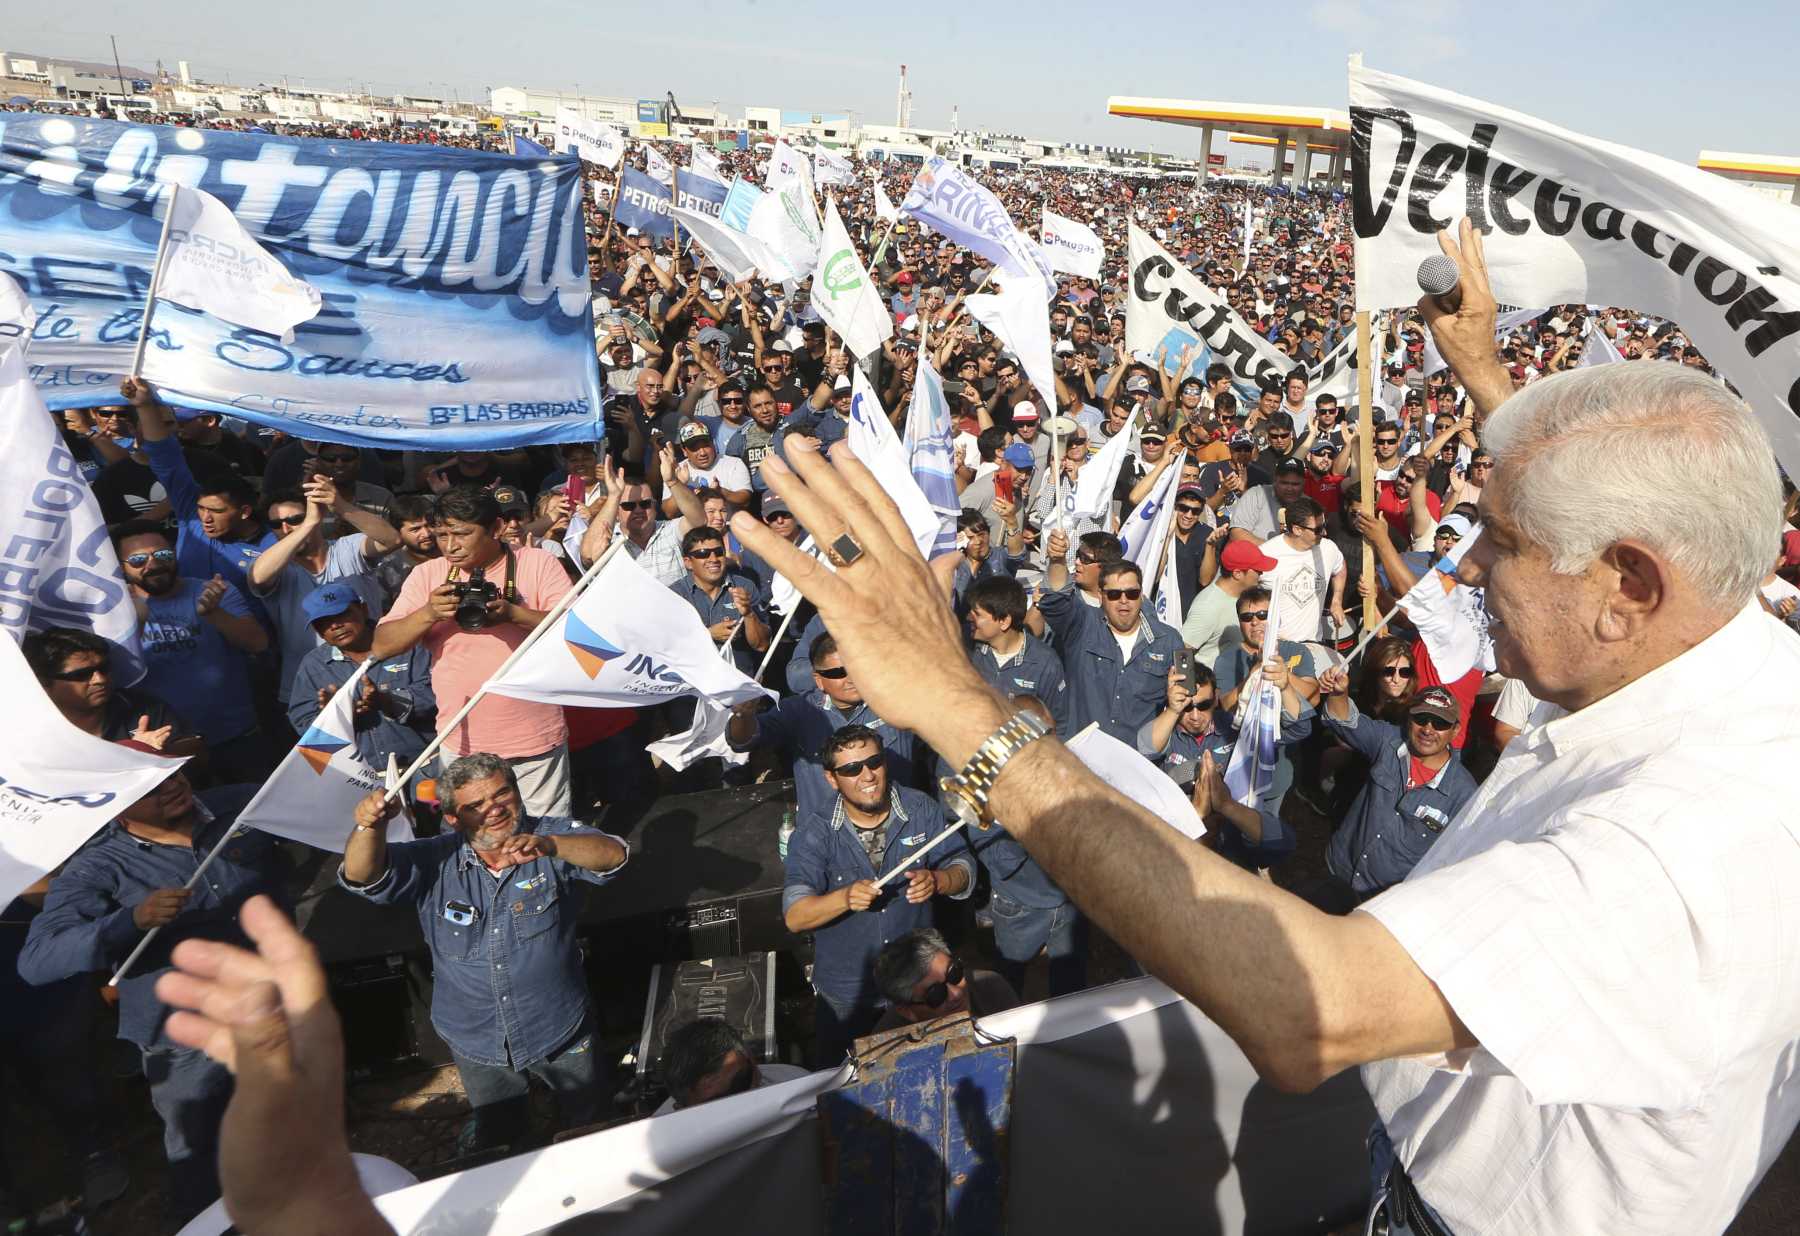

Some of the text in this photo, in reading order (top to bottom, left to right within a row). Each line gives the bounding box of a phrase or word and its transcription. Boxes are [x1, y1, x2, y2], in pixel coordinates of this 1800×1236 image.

[678, 190, 721, 219] PETRO
[216, 328, 470, 383] Sauces
[463, 404, 503, 424] LAS
[508, 400, 590, 420] BARDAS
